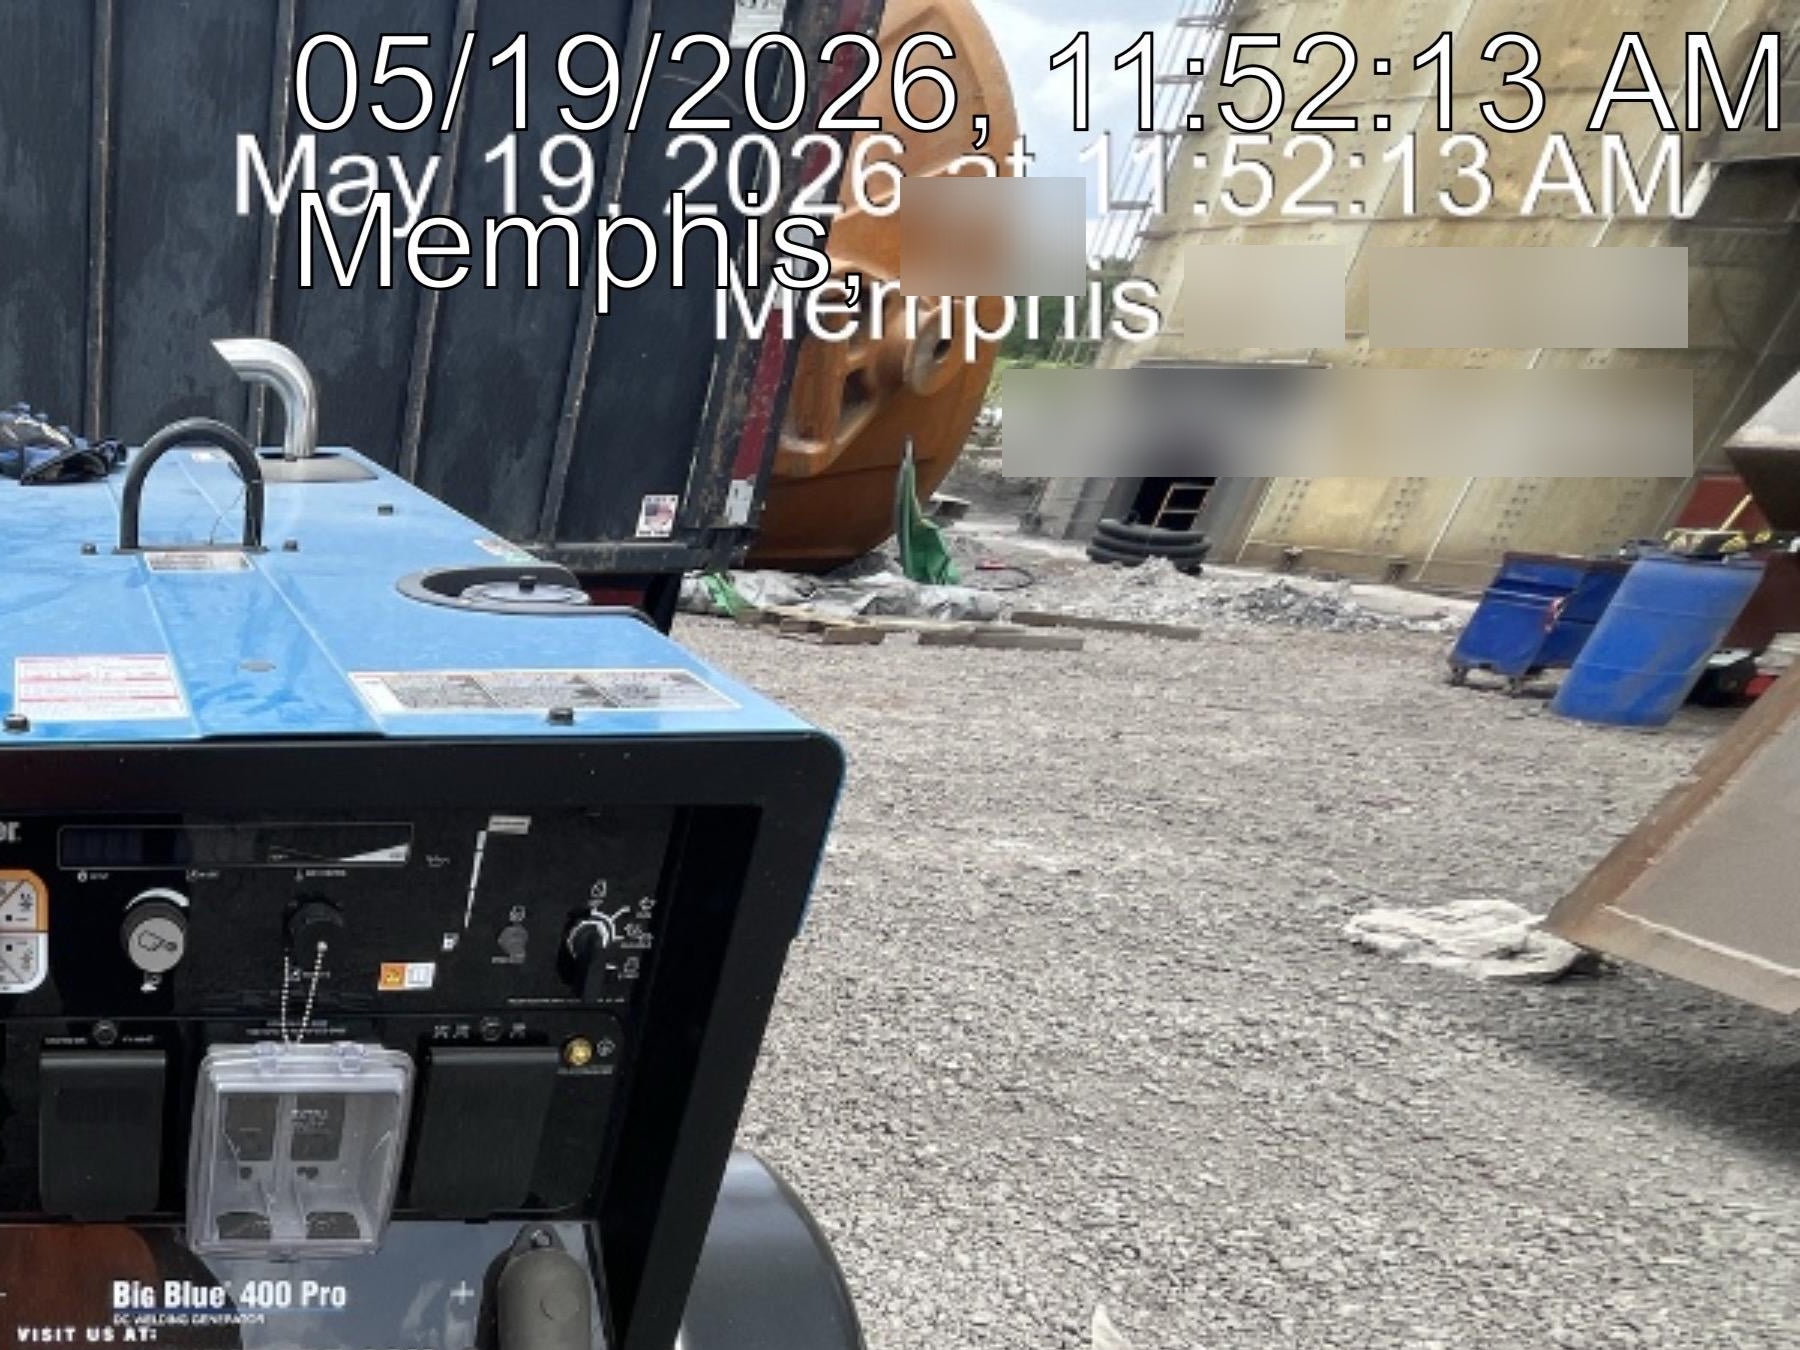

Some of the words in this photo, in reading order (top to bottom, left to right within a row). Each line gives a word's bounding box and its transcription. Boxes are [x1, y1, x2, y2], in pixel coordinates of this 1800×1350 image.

[113, 1281, 156, 1309] Big
[240, 1281, 293, 1308] 400
[302, 1281, 347, 1308] Pro
[134, 1313, 190, 1326] WELDING
[192, 1313, 265, 1325] GENERATOR
[17, 1325, 76, 1342] VISIT
[86, 1325, 115, 1342] US
[123, 1325, 158, 1342] AT:
